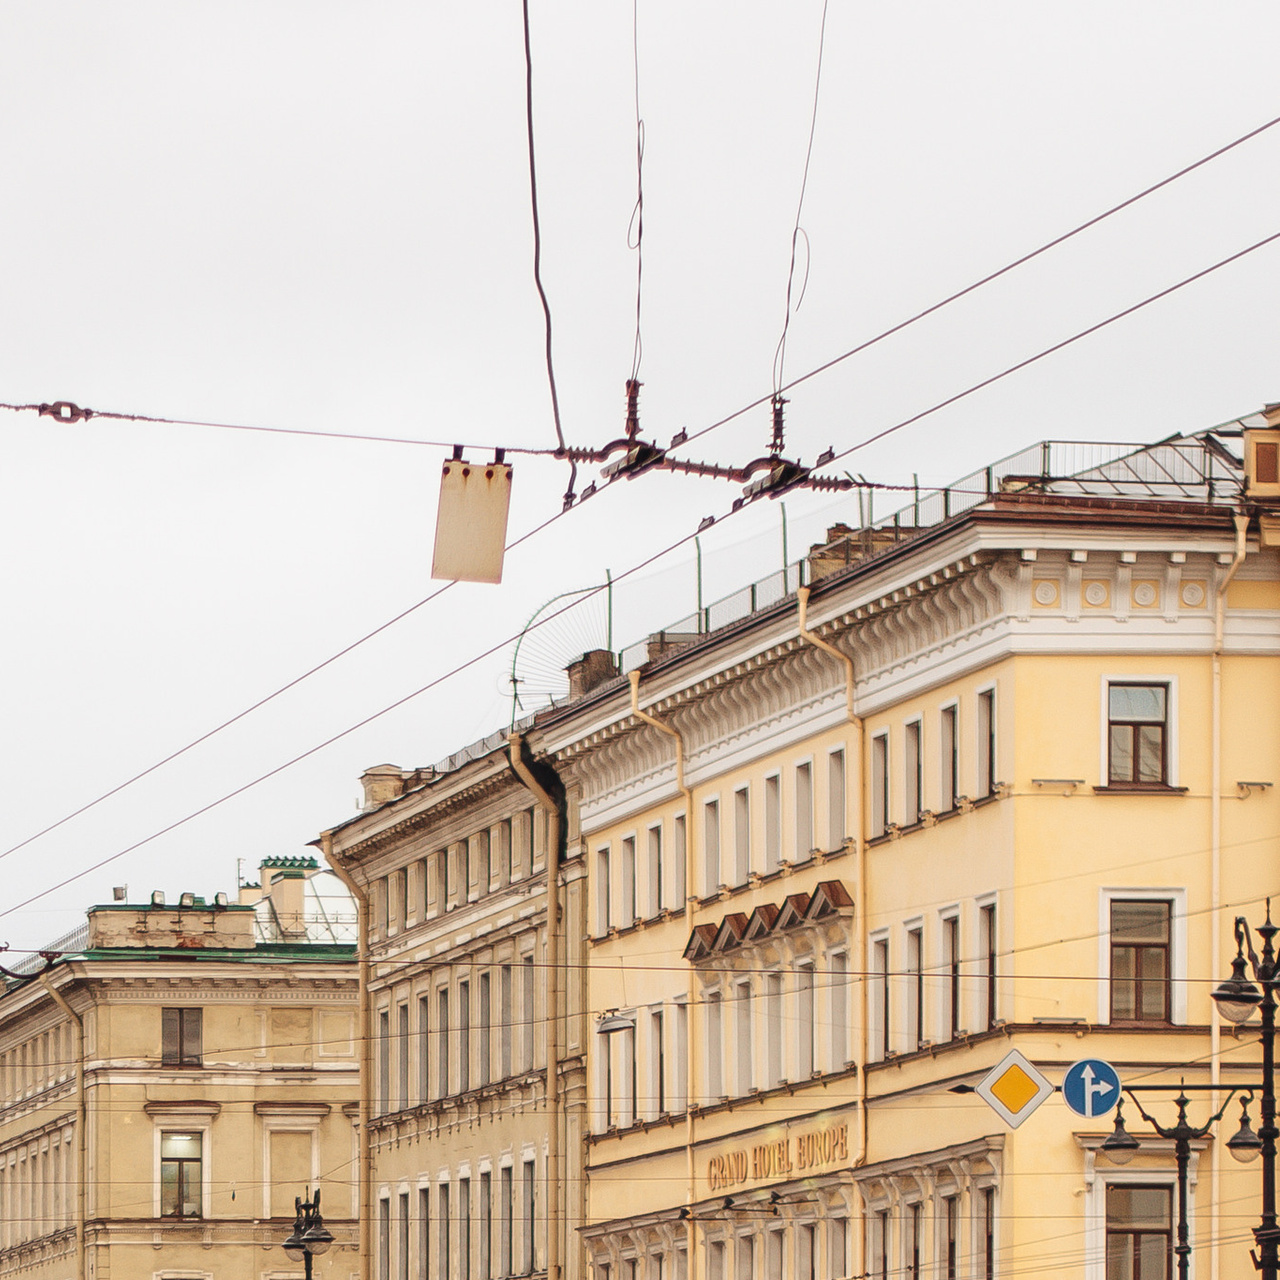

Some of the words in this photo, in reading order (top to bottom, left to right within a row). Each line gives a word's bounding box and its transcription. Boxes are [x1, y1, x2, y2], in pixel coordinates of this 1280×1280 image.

[707, 1149, 748, 1191] GRAND
[752, 1138, 793, 1180] HOTEL
[796, 1124, 849, 1170] EUROPE
